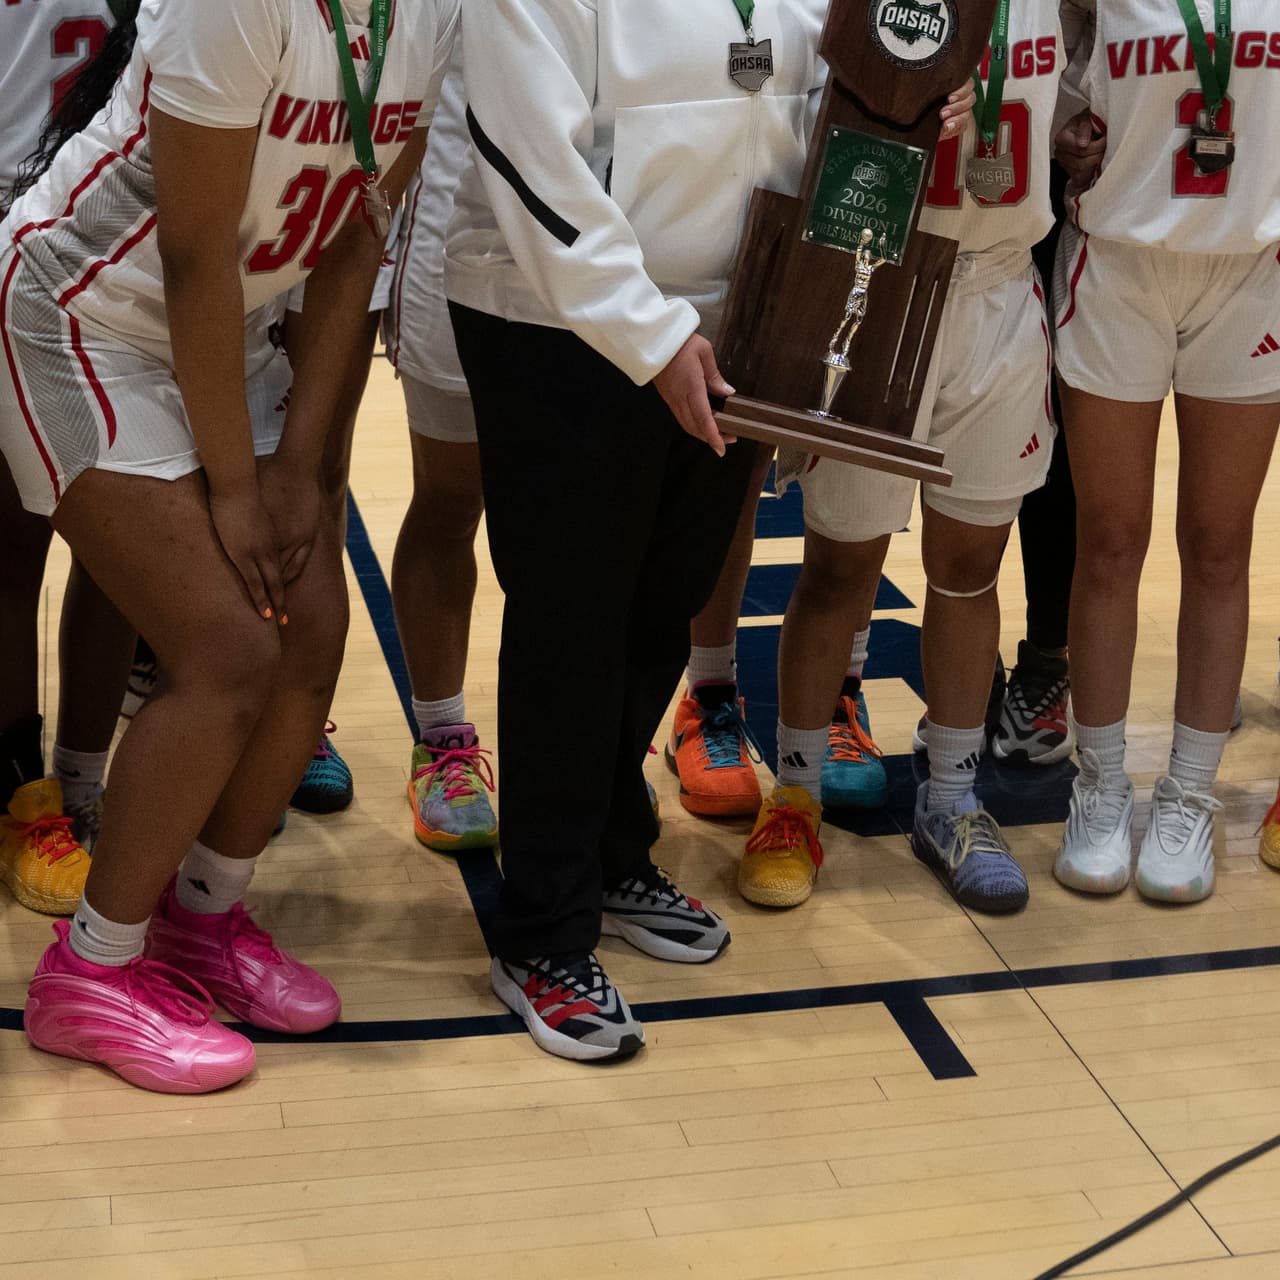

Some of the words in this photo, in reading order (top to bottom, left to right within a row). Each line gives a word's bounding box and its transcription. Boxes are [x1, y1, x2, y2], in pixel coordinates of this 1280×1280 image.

[884, 6, 941, 38] OHSAA
[997, 0, 1009, 37] ASSOCIATION
[377, 15, 387, 57] ASSOCIATION
[732, 56, 771, 71] OHSAA
[1171, 88, 1235, 199] 2
[969, 171, 1013, 185] OHSAA
[840, 187, 888, 214] 2026
[246, 164, 382, 275] 30
[822, 205, 888, 231] DIVISION
